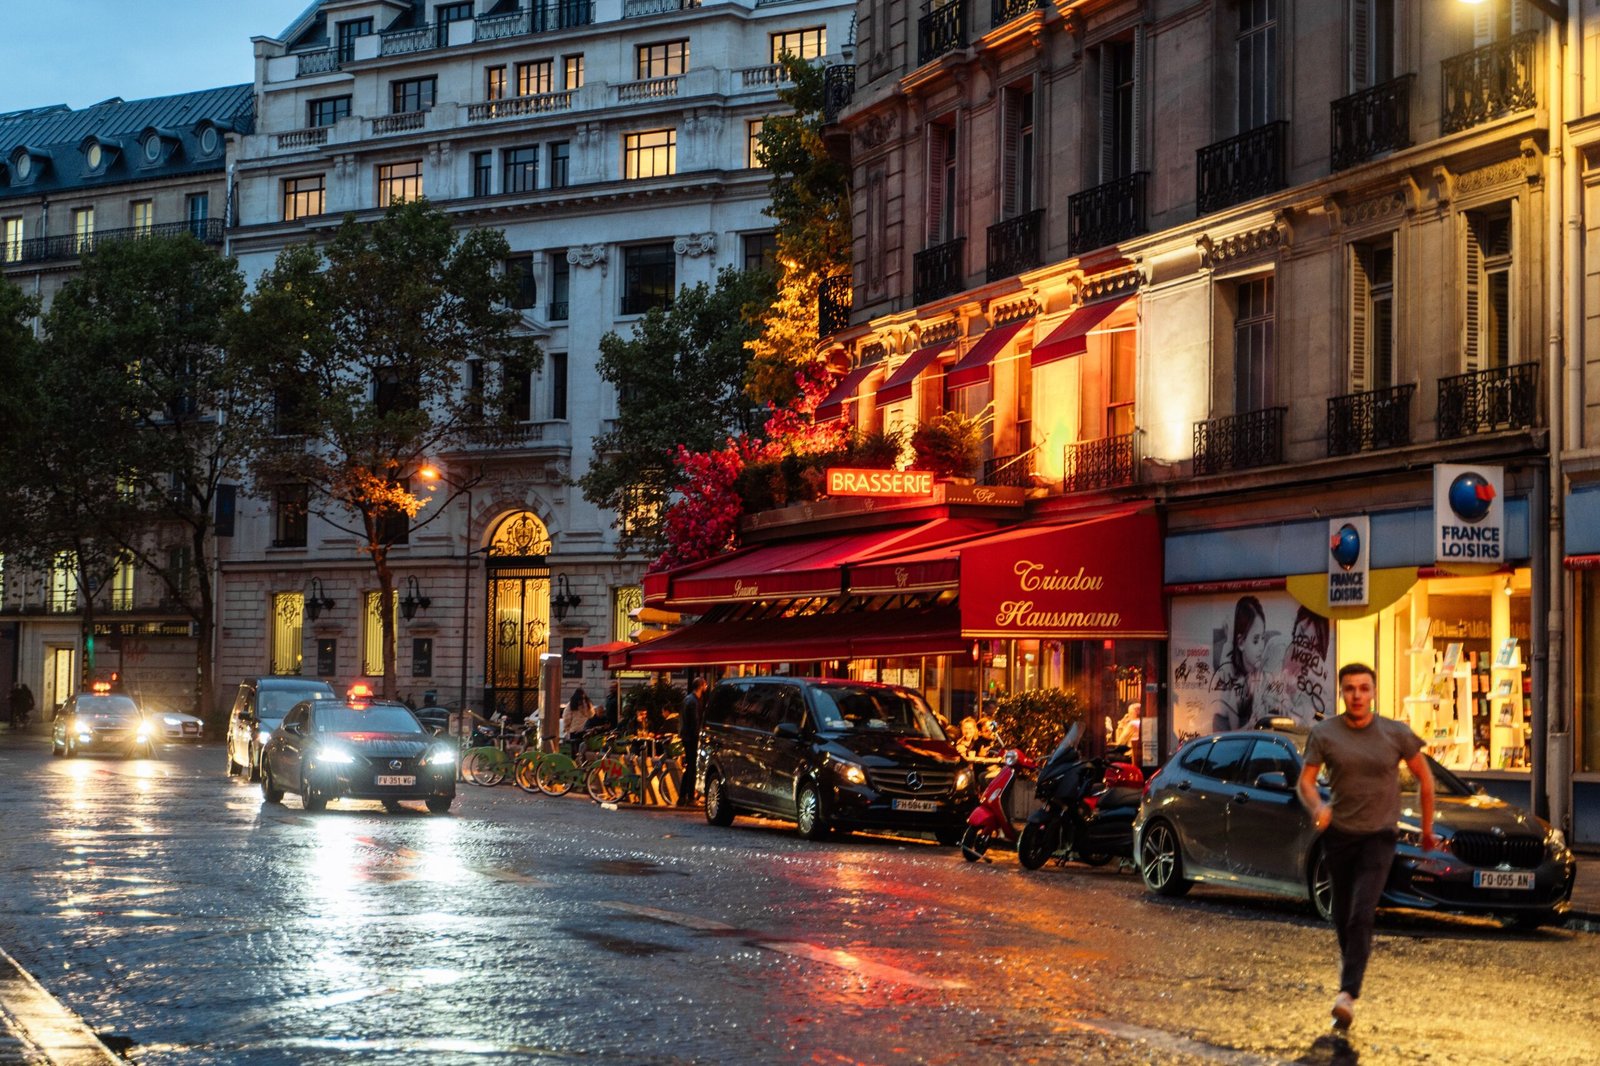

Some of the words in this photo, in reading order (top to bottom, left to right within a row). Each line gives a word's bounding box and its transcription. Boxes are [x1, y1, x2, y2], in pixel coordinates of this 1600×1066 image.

[831, 472, 931, 494] BRASSERIE
[1441, 526, 1500, 542] FRANCE
[1441, 542, 1500, 558] LOISIRS
[1013, 560, 1104, 592] Triadou
[1330, 572, 1364, 587] FRANCE
[1330, 587, 1364, 602] LOISIRS
[995, 600, 1122, 627] Haussmann
